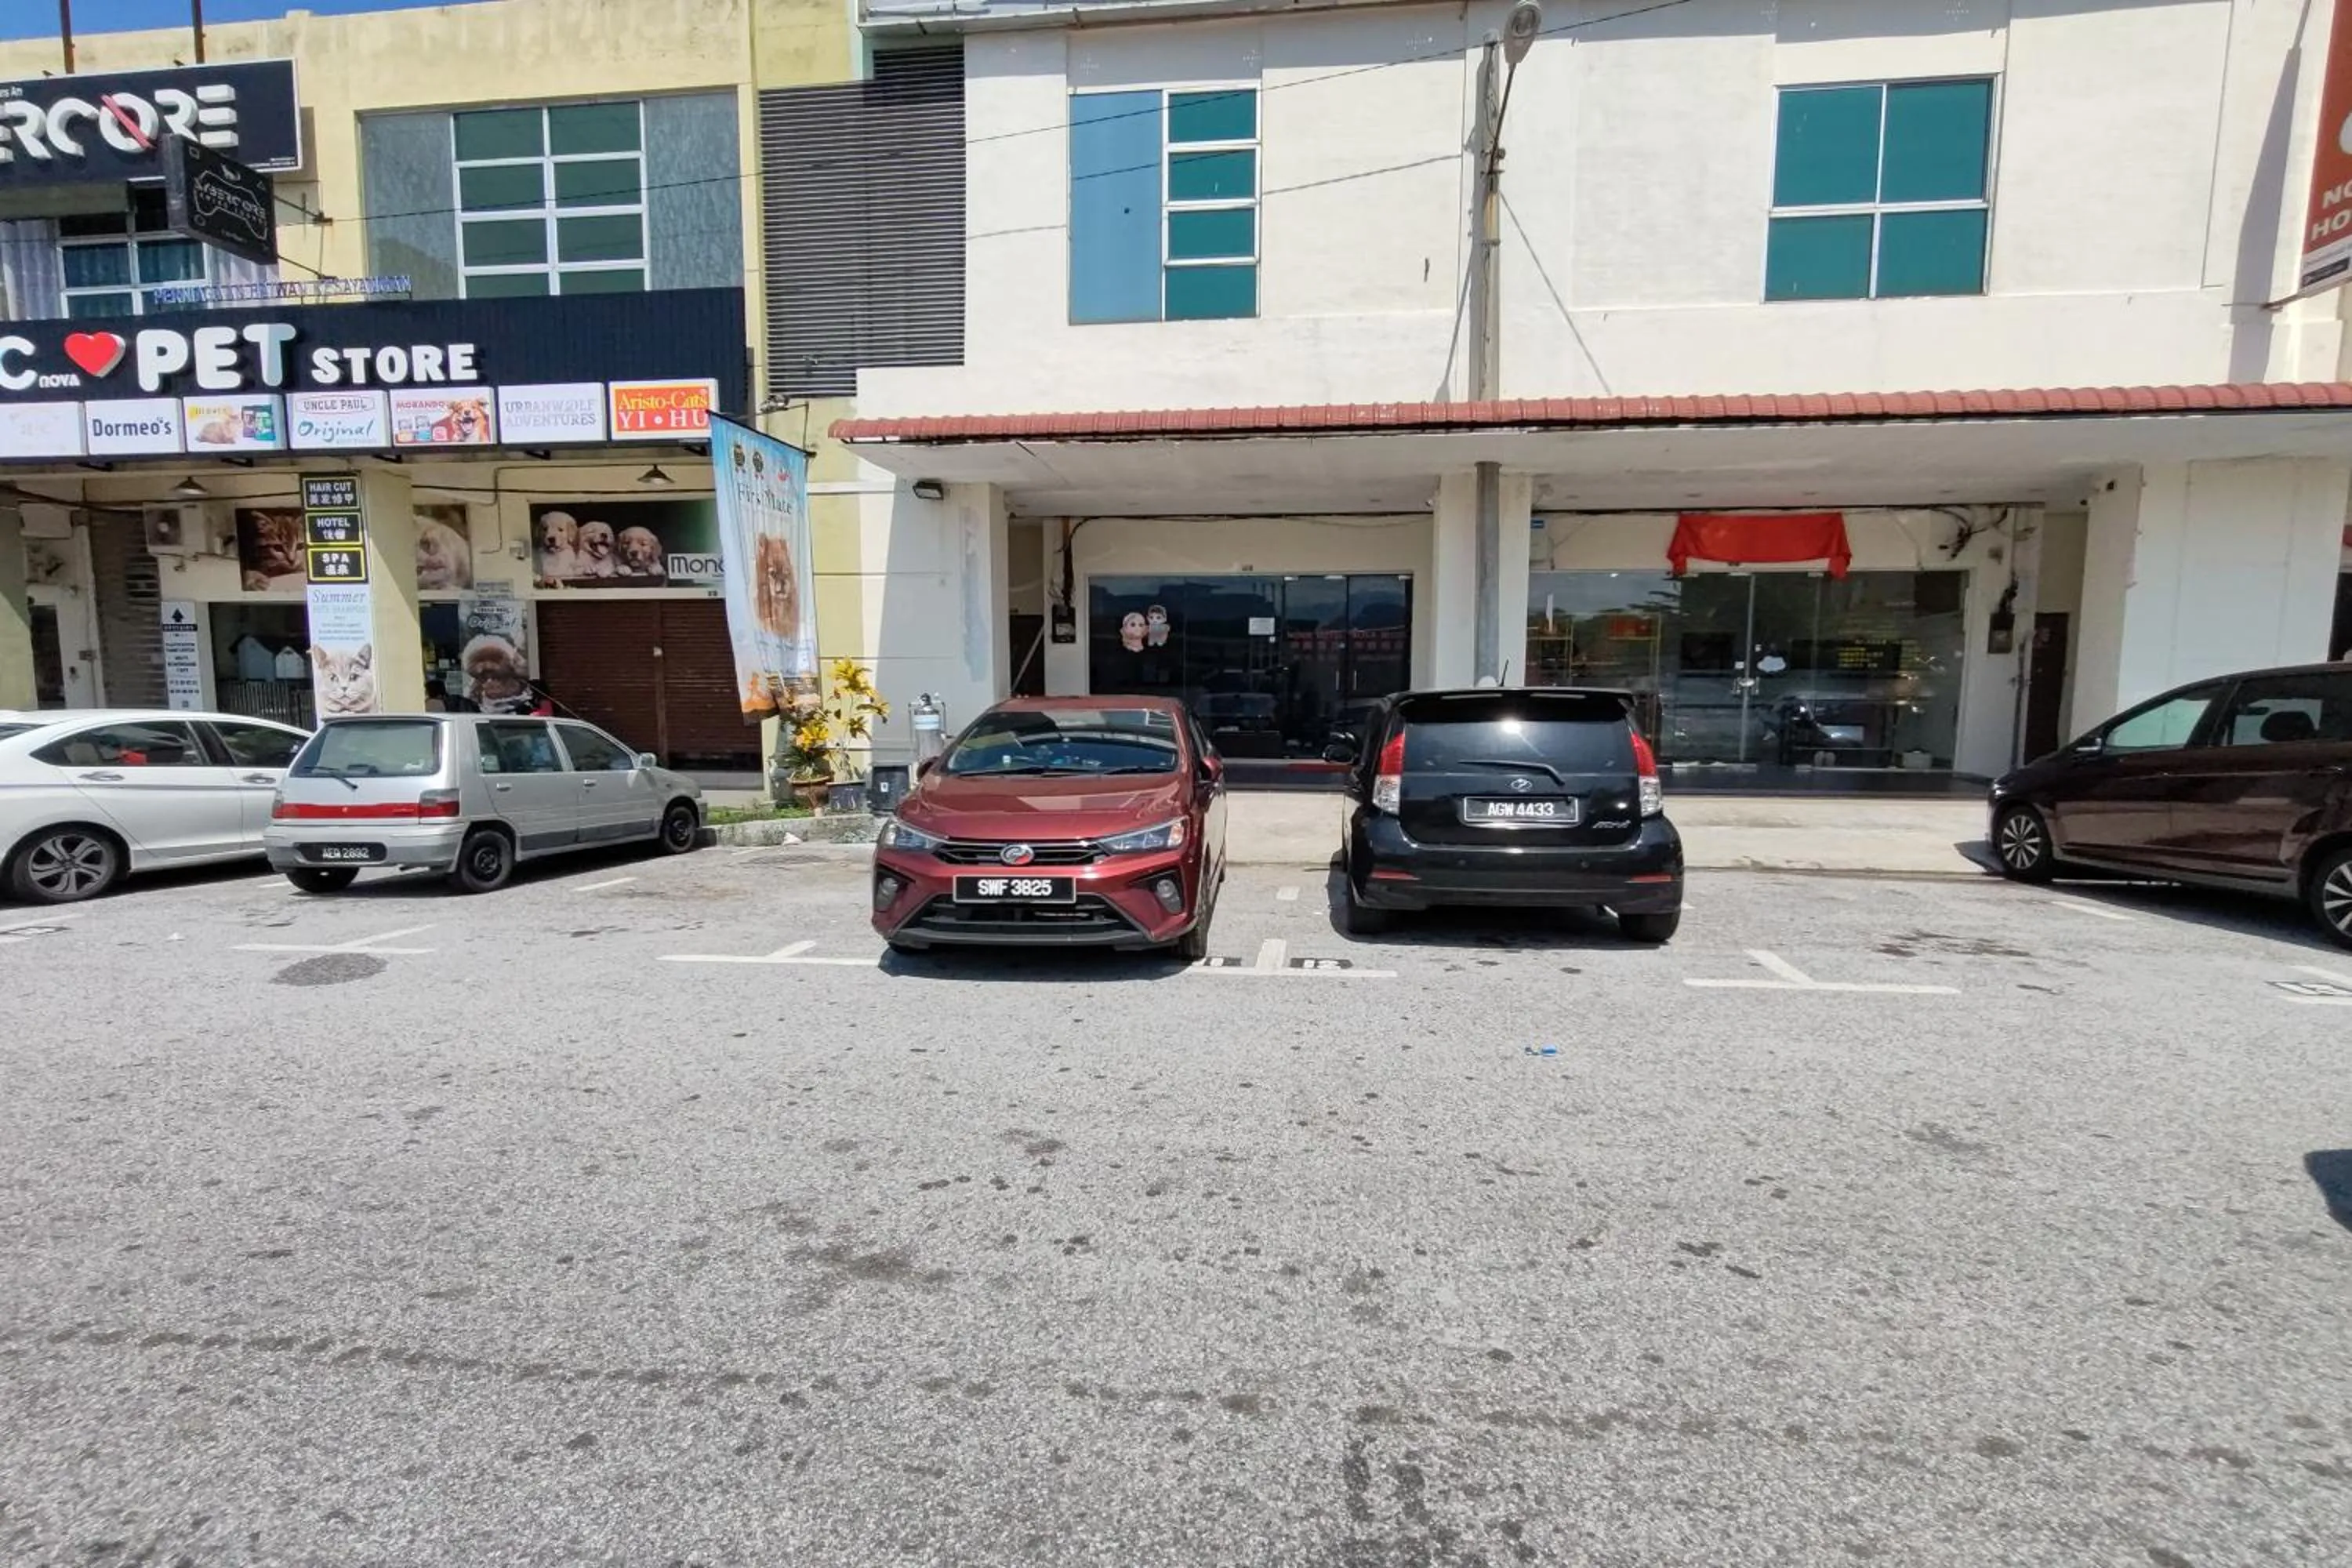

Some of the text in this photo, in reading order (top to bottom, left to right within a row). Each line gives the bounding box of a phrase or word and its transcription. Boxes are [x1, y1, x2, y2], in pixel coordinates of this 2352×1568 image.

[136, 323, 297, 392] PET
[312, 343, 478, 384] STORE
[303, 398, 367, 411] UNCLE PAUL
[505, 412, 597, 427] ADVENTURES
[670, 408, 709, 427] HU
[298, 419, 374, 442] Original
[309, 481, 351, 492] HAIR CUT
[317, 517, 350, 527] HOTEL
[312, 589, 366, 603] Summer
[1487, 802, 1554, 816] AGW 4433
[978, 879, 1052, 896] SWF 3825
